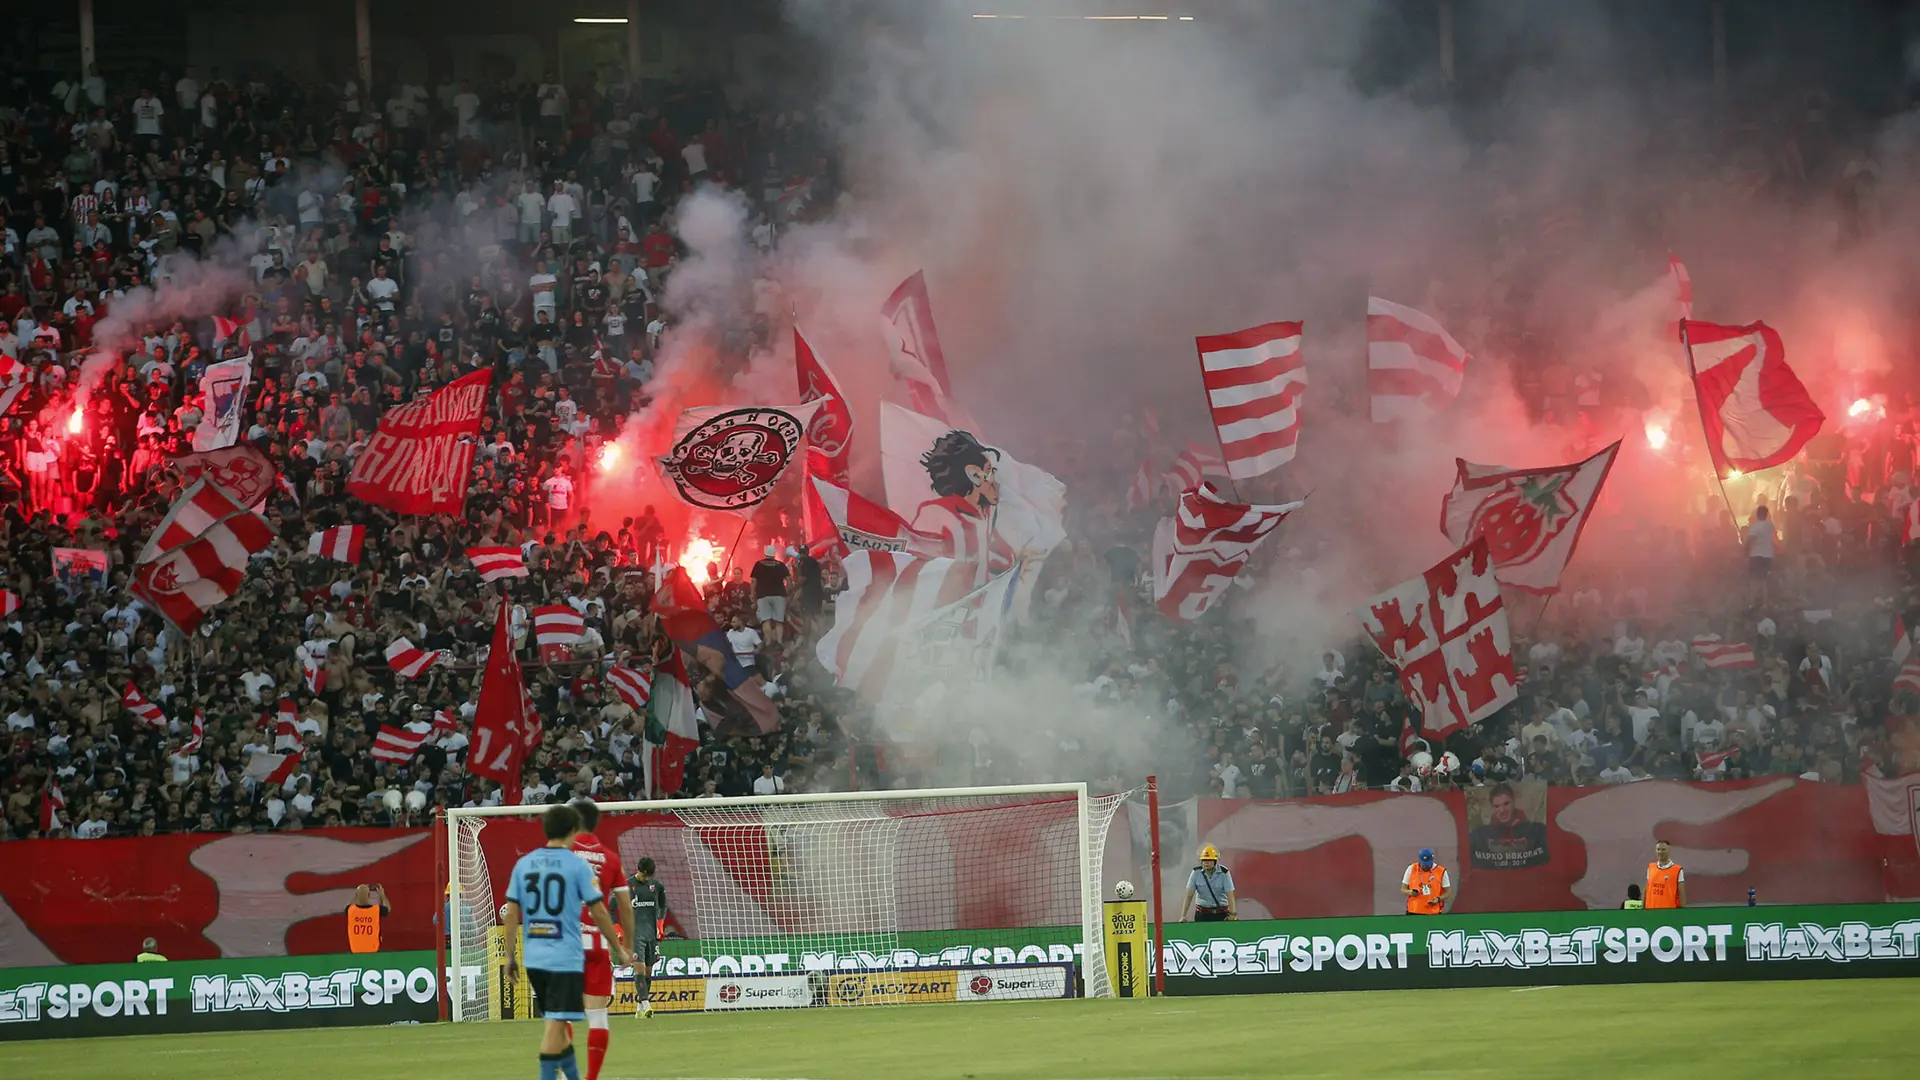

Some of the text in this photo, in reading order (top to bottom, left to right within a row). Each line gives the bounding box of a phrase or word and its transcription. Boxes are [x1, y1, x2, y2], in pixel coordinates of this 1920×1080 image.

[524, 872, 565, 916] 30
[1111, 911, 1136, 923] aqua
[354, 925, 373, 935] 070
[1148, 934, 1290, 979] AXBET
[1289, 933, 1414, 973] SPORT
[1603, 924, 1733, 964] SPORT
[1121, 951, 1129, 987] ISOTONIC
[872, 982, 951, 995] MOZZART
[997, 979, 1055, 991] SuperLiga
[47, 978, 174, 1019] SPORT
[503, 979, 511, 1009] ISOTON
[620, 990, 699, 1004] MZZART
[745, 986, 803, 1000] SuperLiga
